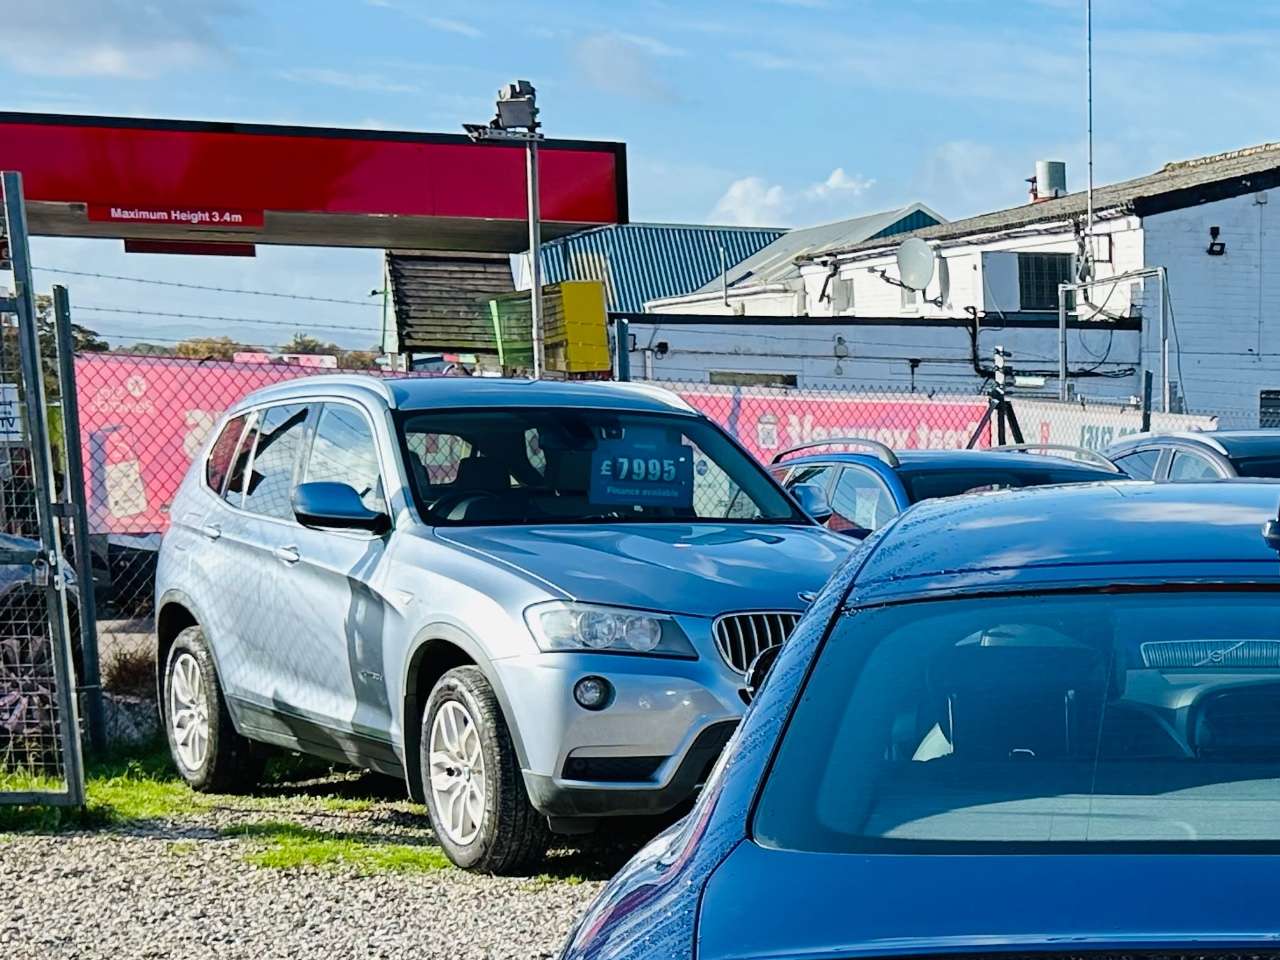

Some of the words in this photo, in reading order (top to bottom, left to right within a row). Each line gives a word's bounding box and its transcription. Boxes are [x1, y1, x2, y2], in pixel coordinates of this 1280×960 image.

[110, 207, 168, 220] Maximum
[171, 210, 209, 223] Height
[212, 211, 243, 222] 3.4m
